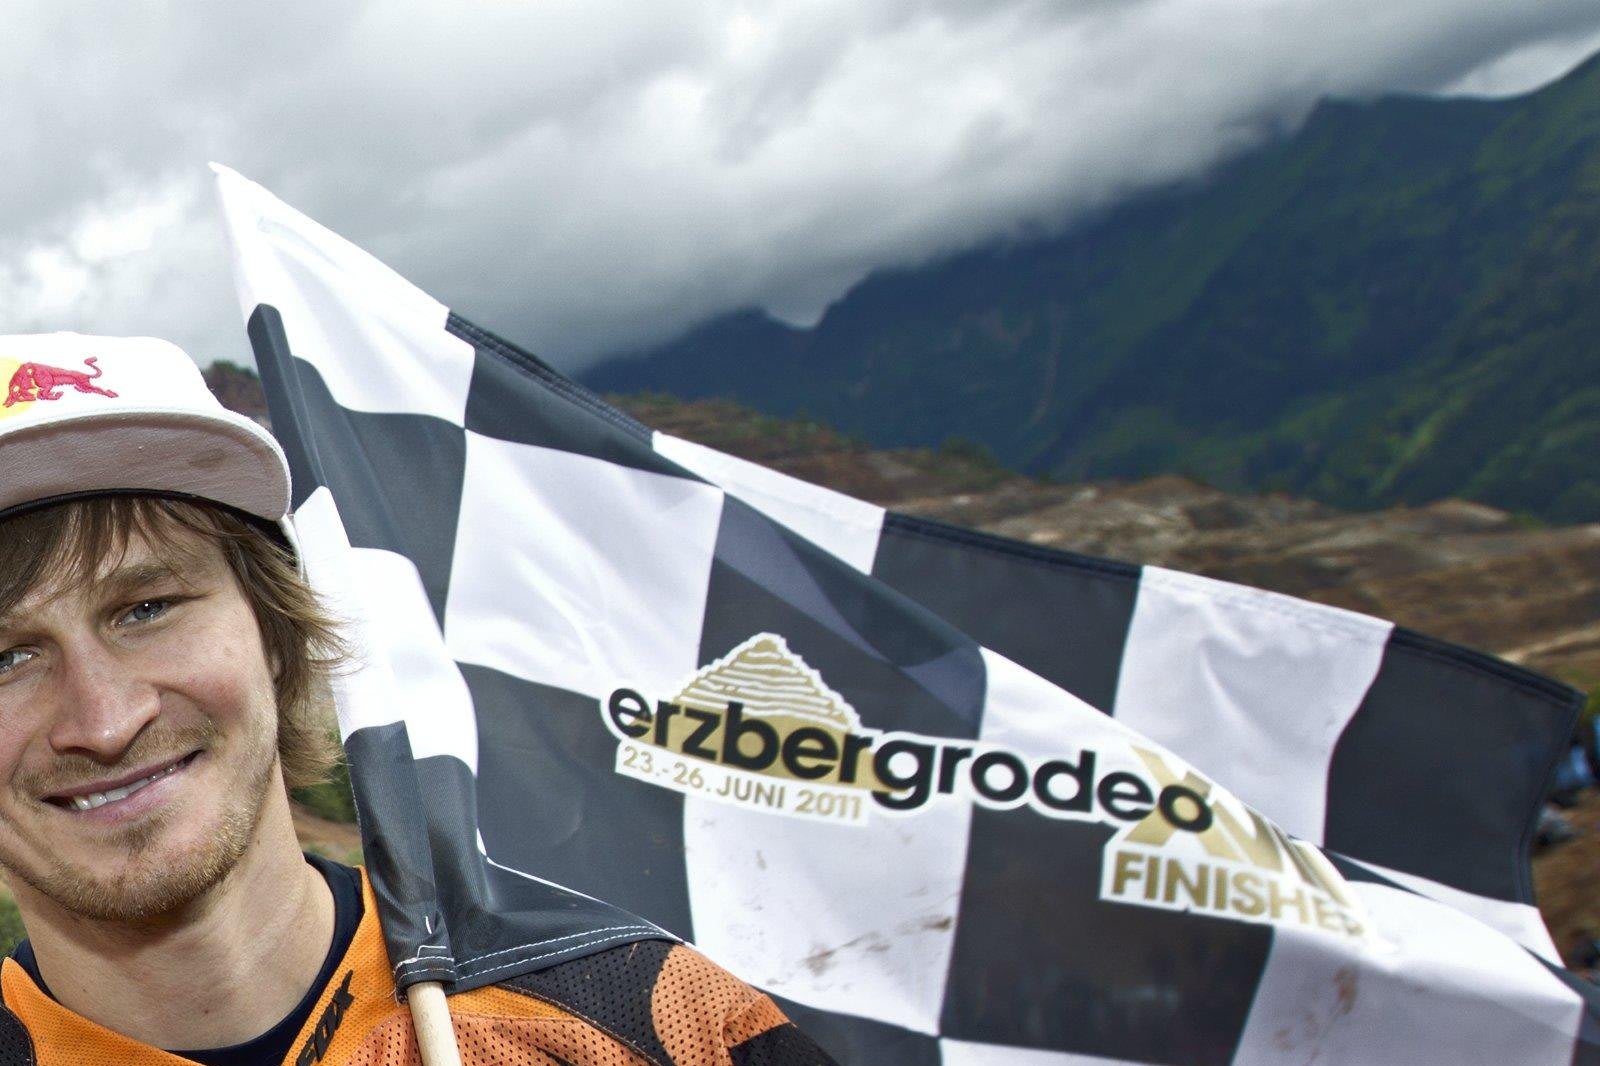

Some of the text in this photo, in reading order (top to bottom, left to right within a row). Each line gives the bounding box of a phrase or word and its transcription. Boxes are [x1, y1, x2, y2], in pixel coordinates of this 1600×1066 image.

[608, 687, 1215, 834] erzbergrodeo
[716, 775, 786, 809] JUNI
[795, 790, 864, 820] 2011
